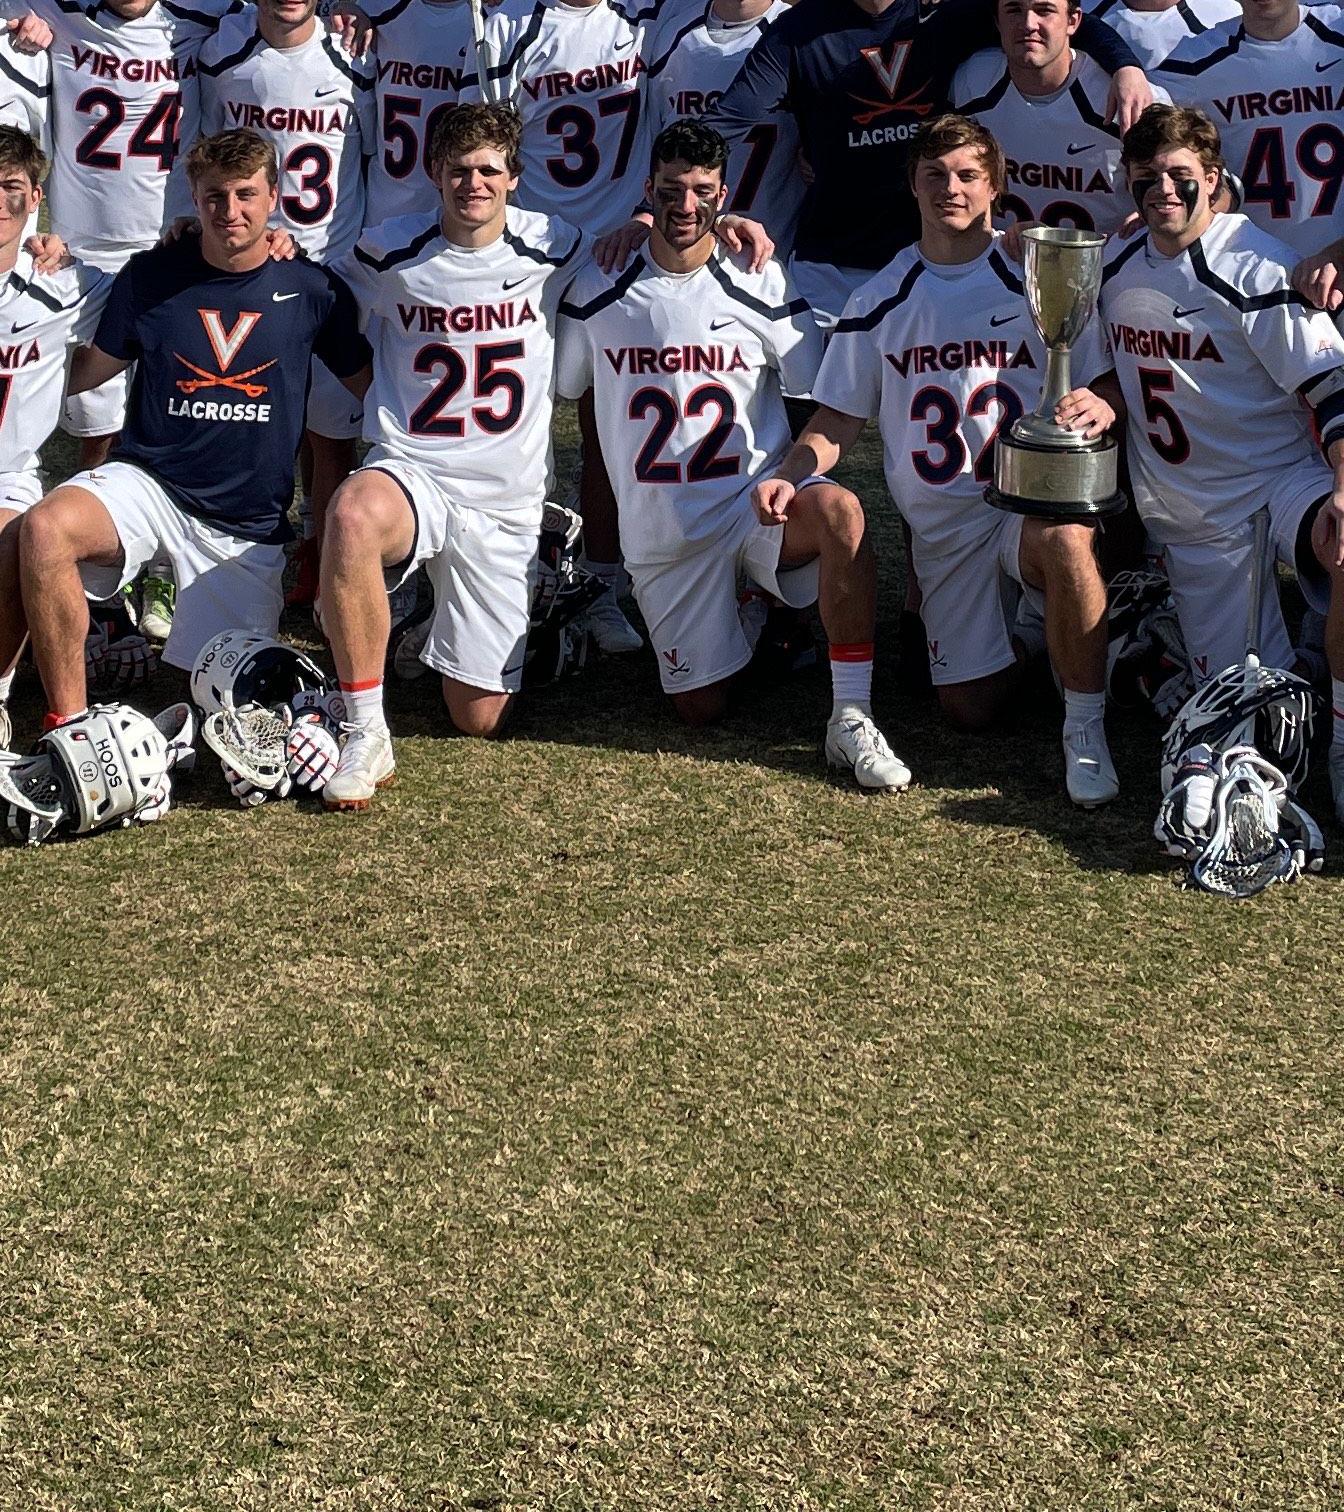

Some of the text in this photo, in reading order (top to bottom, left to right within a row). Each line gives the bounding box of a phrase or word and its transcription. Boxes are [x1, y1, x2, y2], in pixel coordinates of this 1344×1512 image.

[70, 44, 199, 84] VIRGINIA
[376, 59, 464, 92] VIRGIN
[521, 52, 650, 102] VIRGINIA
[74, 86, 184, 173] 24
[226, 100, 348, 133] VIRGINIA
[848, 123, 919, 148] LACROS
[545, 88, 642, 189] 37
[281, 142, 335, 226] 3
[1004, 157, 1115, 194] RGINIA
[397, 298, 538, 334] VIRGINIA
[603, 344, 752, 376] VIRGINIA
[884, 339, 1037, 380] VIRGINIA
[1110, 322, 1225, 364] VIRGINIA
[409, 338, 526, 438] 25
[167, 396, 272, 423] LACROSSE
[1137, 366, 1191, 465] 5
[627, 382, 742, 484] 22
[910, 380, 1025, 486] 32
[303, 694, 316, 706] 25
[95, 739, 123, 789] HOOS
